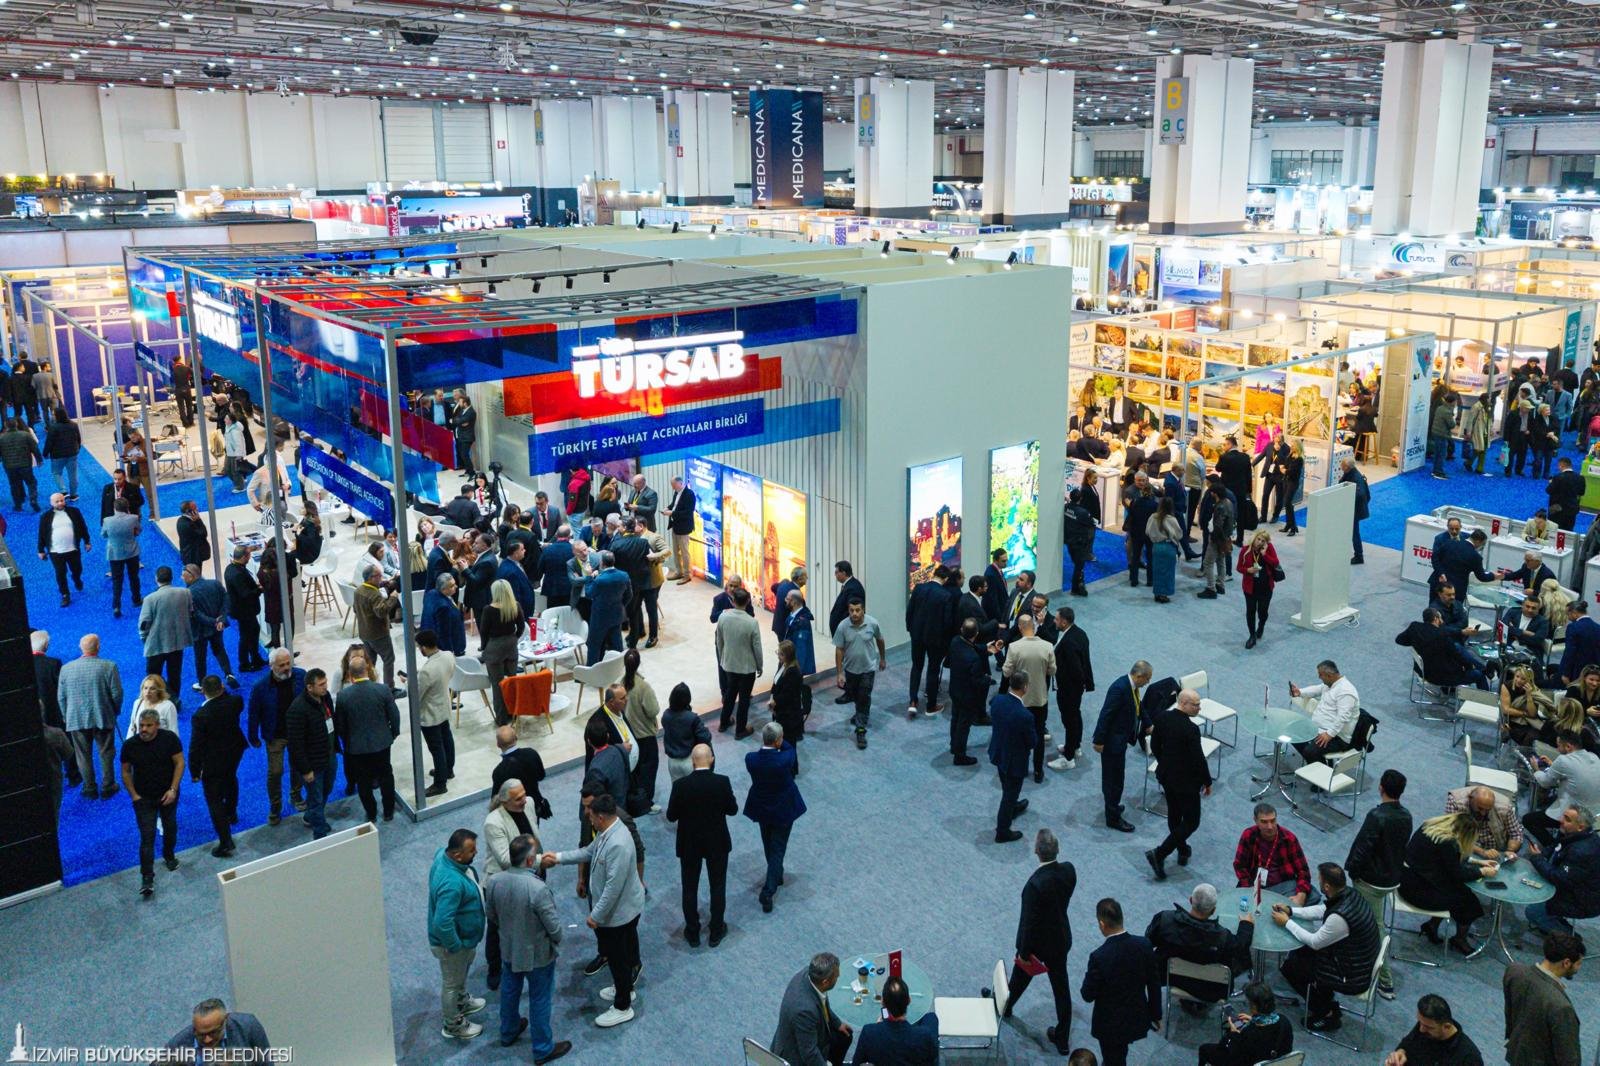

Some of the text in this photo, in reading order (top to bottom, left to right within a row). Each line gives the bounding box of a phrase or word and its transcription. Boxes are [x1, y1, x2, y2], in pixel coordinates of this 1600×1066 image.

[1167, 81, 1183, 109] B
[861, 97, 871, 120] B
[859, 126, 873, 137] a c
[1162, 118, 1185, 132] a c
[755, 108, 766, 201] MEDICANA
[791, 109, 804, 199] MEDICANA
[551, 412, 749, 457] TÜRKİYE SEYAHAT ACENTALARI BİRLİĞİ
[1413, 545, 1433, 560] TÜR
